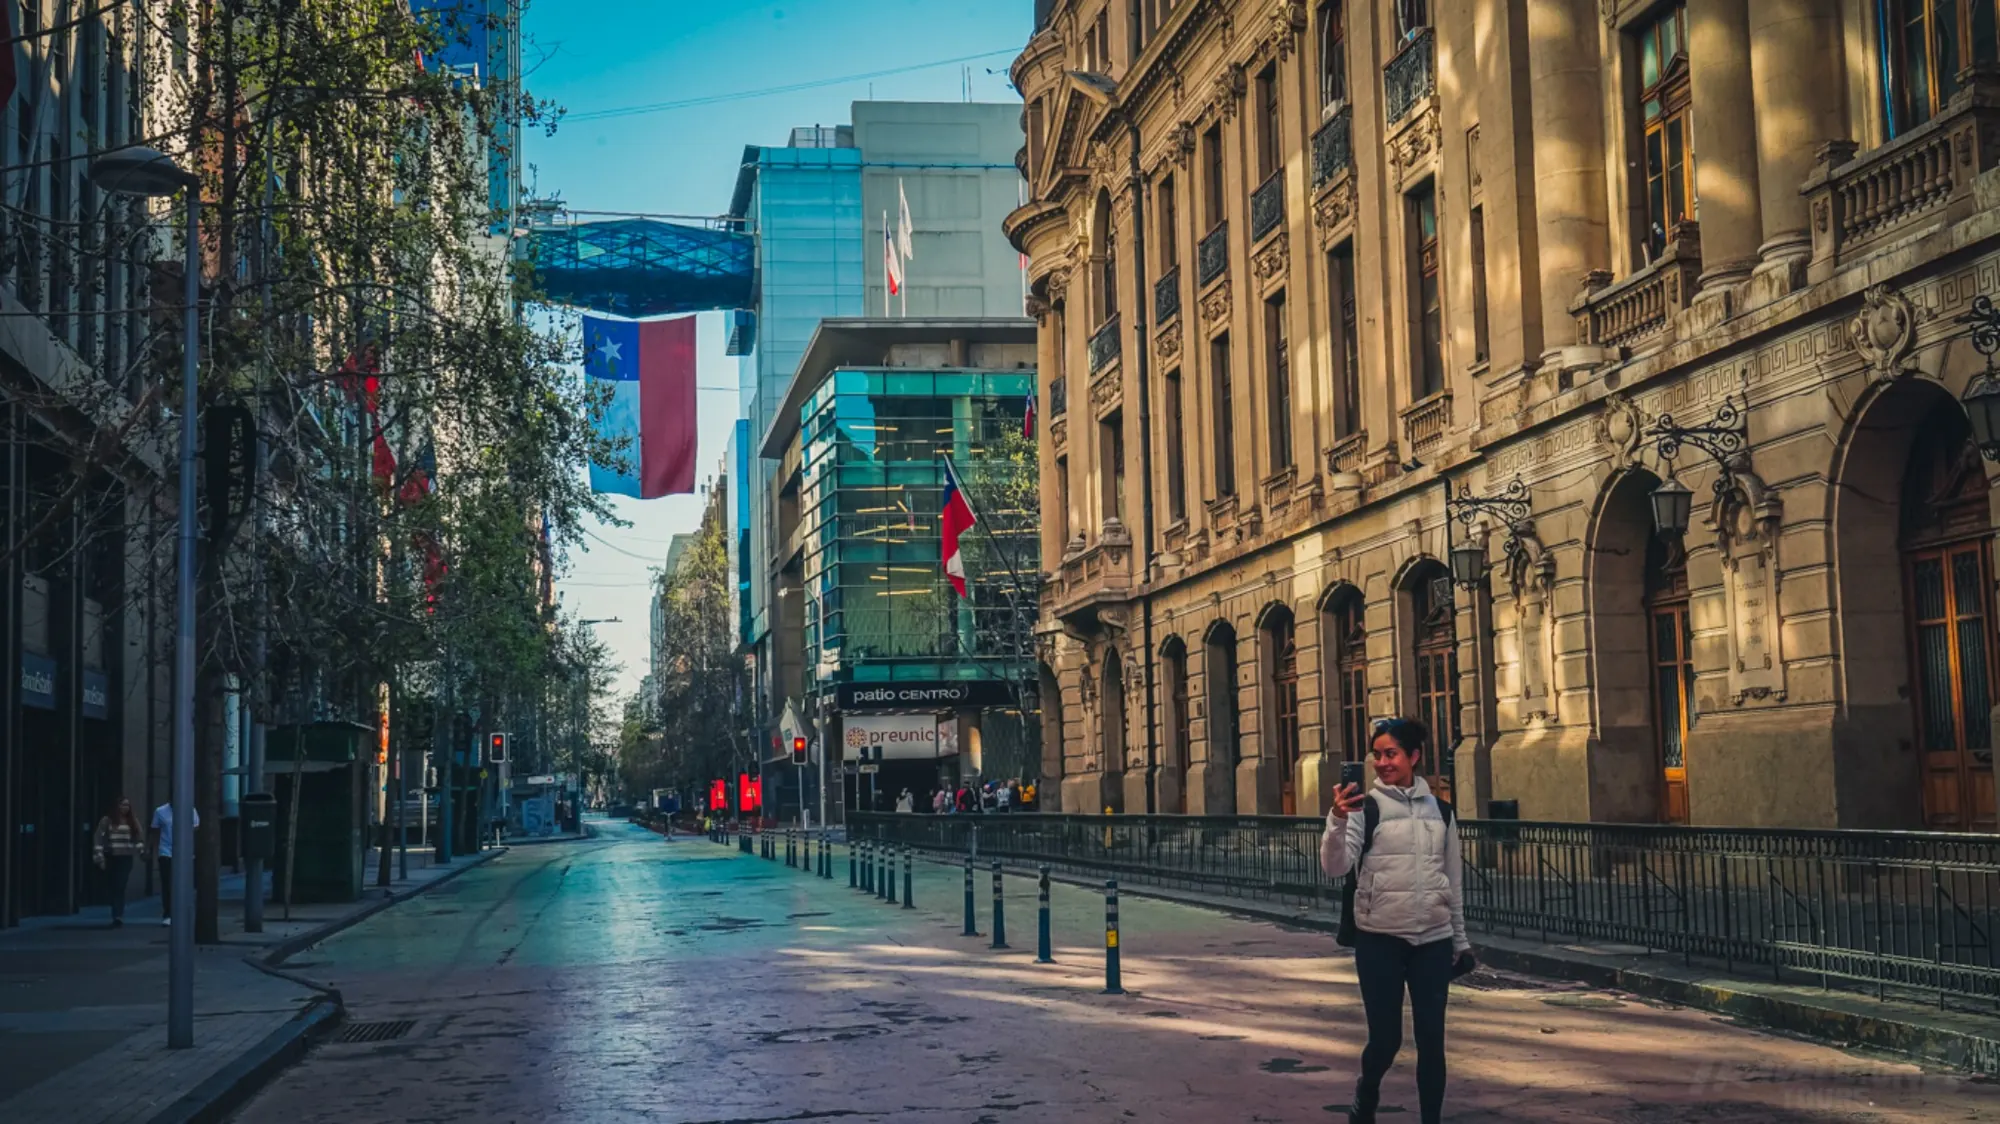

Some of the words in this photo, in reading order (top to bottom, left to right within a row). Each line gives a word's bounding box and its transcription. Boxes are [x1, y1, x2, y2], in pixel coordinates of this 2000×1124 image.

[853, 687, 896, 704] patio
[898, 688, 961, 701] CENTRO
[869, 727, 935, 745] preunic
